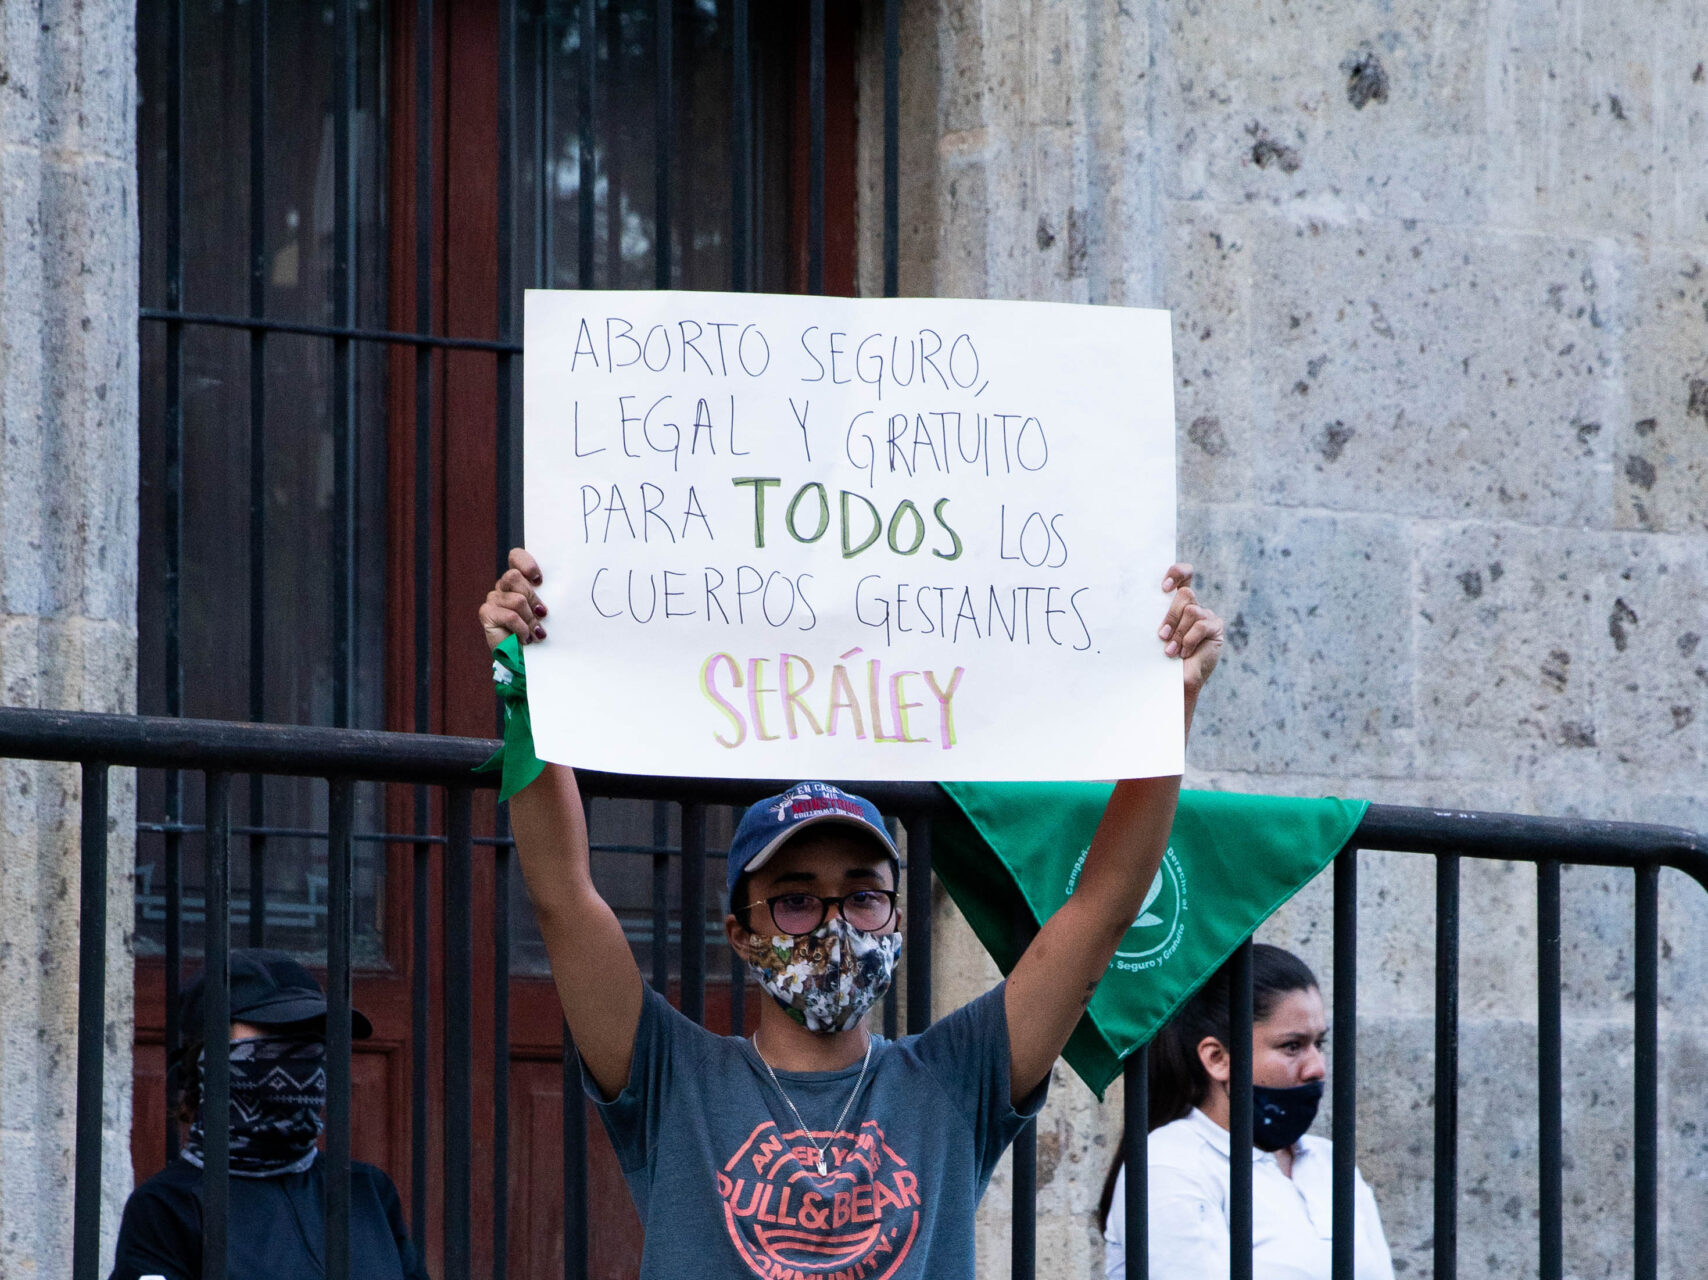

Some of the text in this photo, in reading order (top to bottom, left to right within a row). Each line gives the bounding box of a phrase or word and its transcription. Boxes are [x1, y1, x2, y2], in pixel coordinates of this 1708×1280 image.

[571, 317, 990, 400] ABORTO SEGURO,
[573, 394, 1049, 488] LEGAL Y GRATUITO
[581, 476, 1068, 569] PARA TODOS LOS
[590, 565, 1101, 654] CUERPOS GESTANTES.
[797, 784, 812, 795] EN
[814, 784, 840, 795] CASA
[1117, 960, 1156, 972] Seguro
[1156, 956, 1163, 967] y
[1163, 923, 1184, 959] Gratuito
